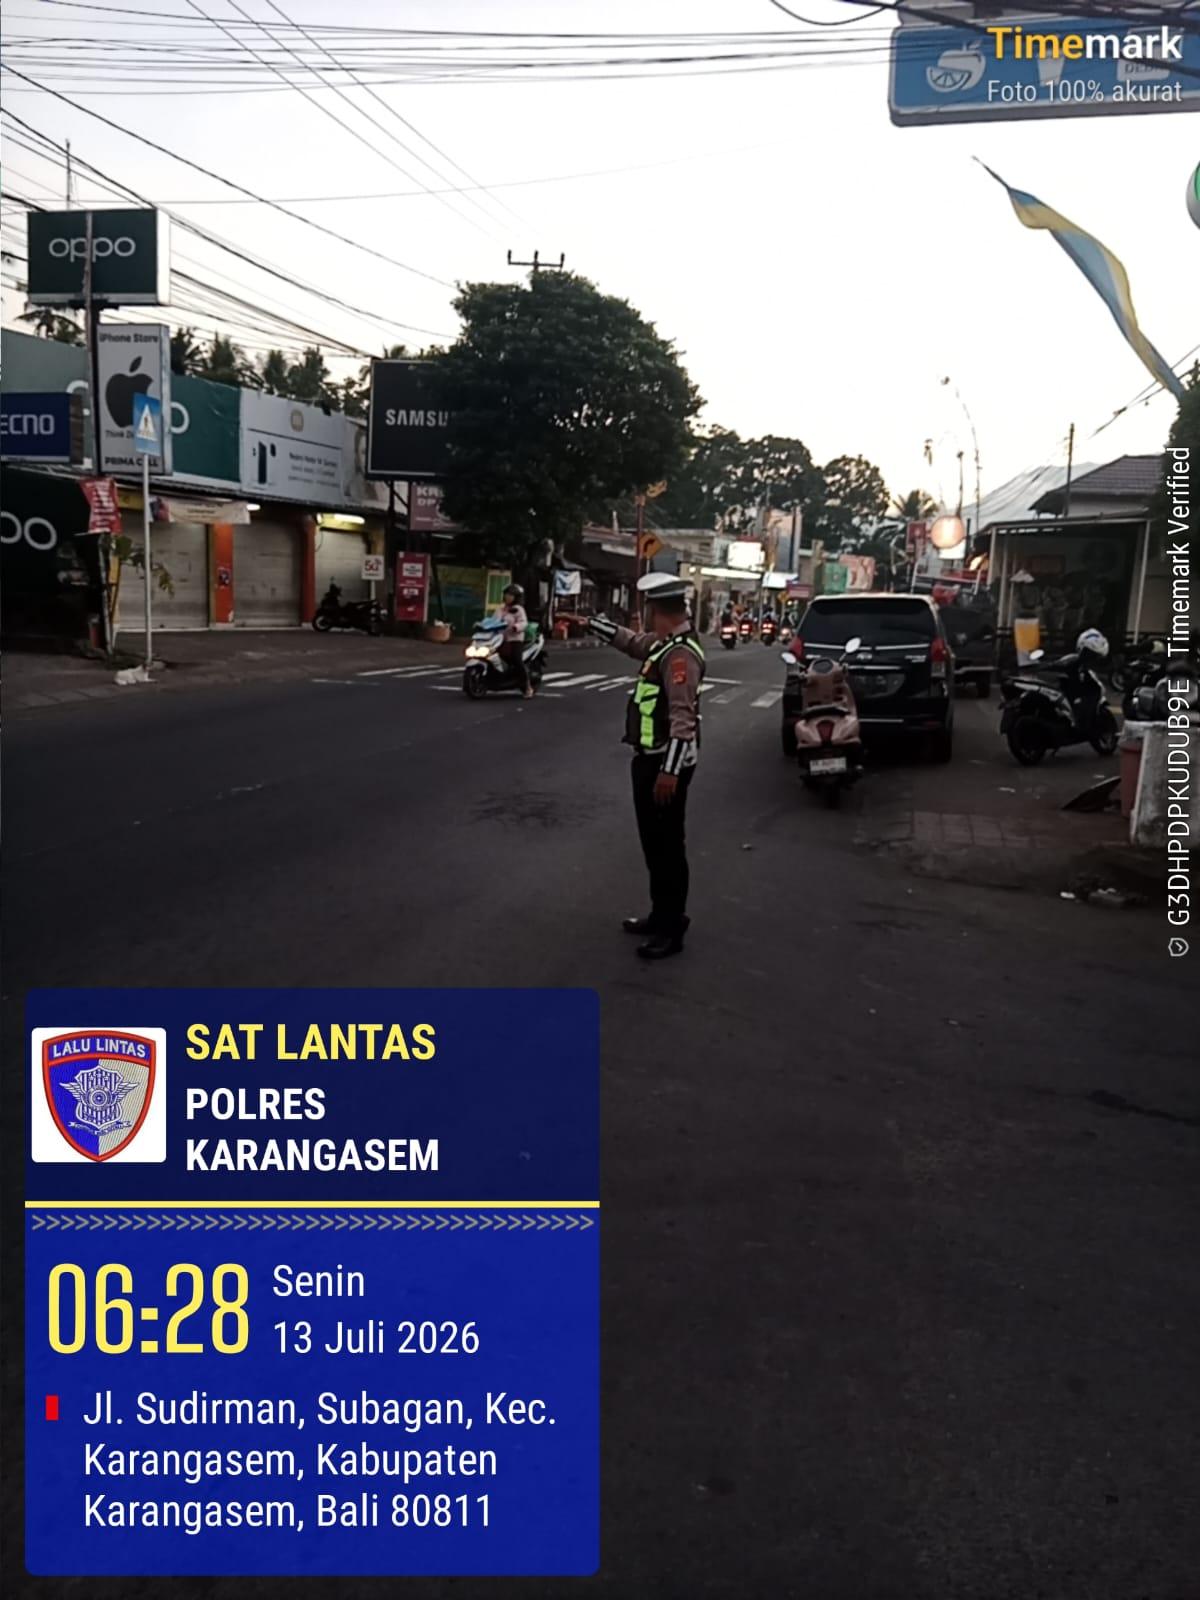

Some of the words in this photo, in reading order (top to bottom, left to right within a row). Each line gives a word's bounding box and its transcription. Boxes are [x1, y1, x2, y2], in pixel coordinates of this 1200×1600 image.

[48, 237, 136, 262] oppo
[134, 332, 158, 343] Store
[385, 408, 448, 427] SAMSU
[105, 456, 135, 466] PRIMA
[136, 457, 159, 468] CLL
